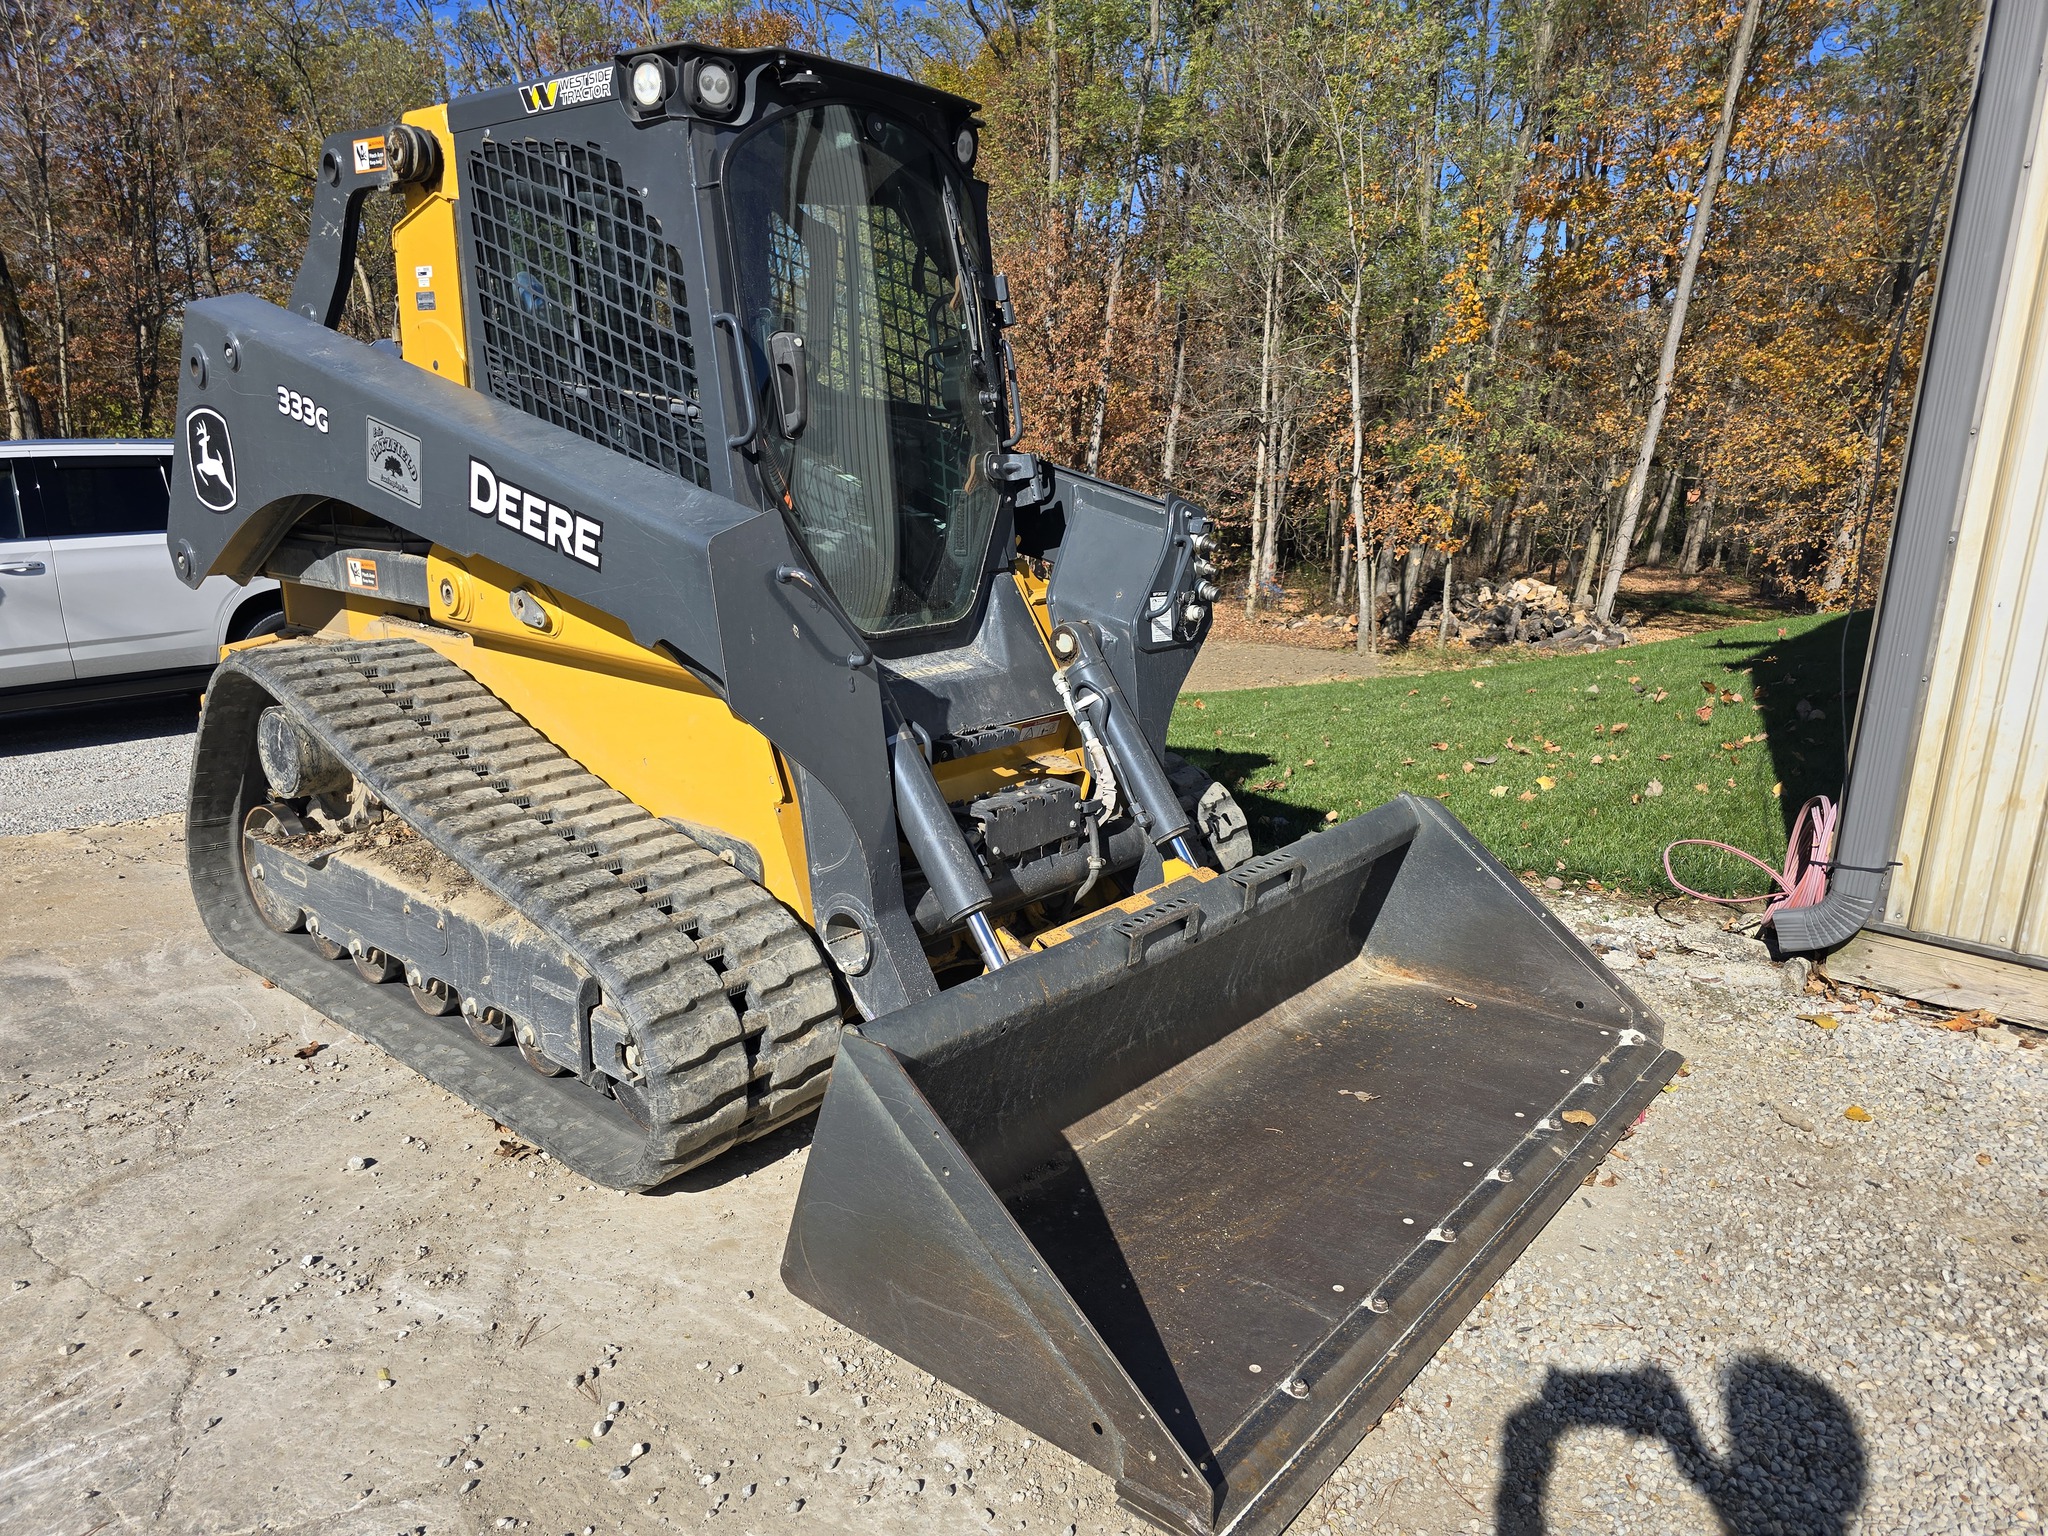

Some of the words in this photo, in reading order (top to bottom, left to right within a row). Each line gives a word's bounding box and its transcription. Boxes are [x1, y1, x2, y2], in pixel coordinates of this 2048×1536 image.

[560, 83, 611, 105] TRACTOR
[277, 385, 329, 434] 333G
[469, 457, 602, 570] DEERE
[922, 661, 976, 677] DEERE
